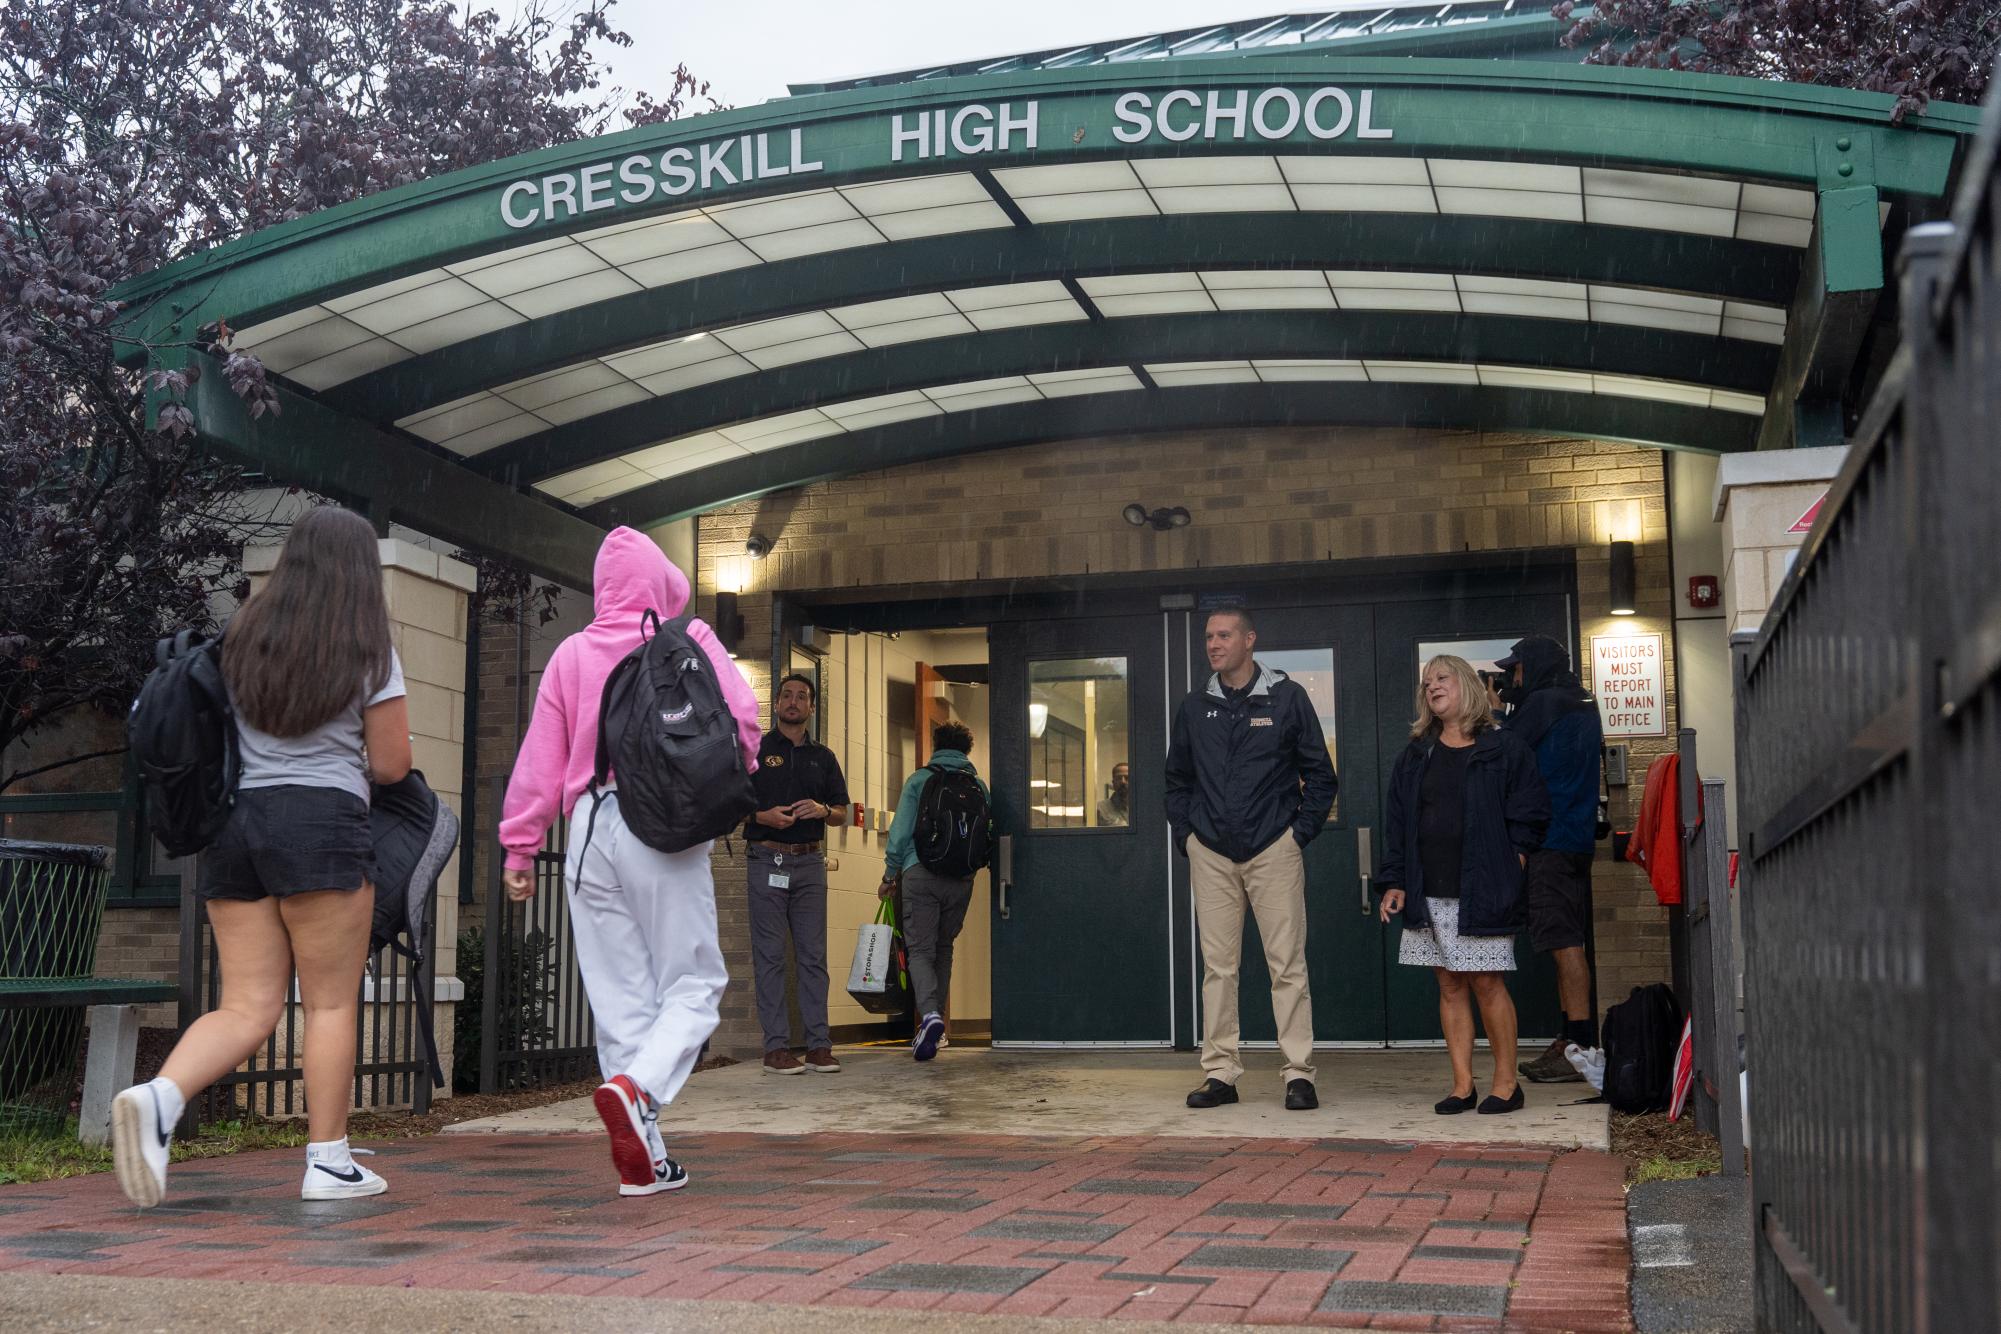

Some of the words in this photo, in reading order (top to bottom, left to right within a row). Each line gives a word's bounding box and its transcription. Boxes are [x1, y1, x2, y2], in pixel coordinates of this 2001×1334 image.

[500, 128, 823, 228] CRESSKILL
[891, 100, 1039, 161] HIGH
[1112, 86, 1394, 143] SCHOOL
[1600, 645, 1654, 659] VISITORS
[1611, 662, 1644, 676] MUST
[1604, 679, 1652, 693] REPORT
[1604, 697, 1619, 710] TO
[1625, 696, 1654, 709] MAIN
[1608, 713, 1651, 727] OFFICE
